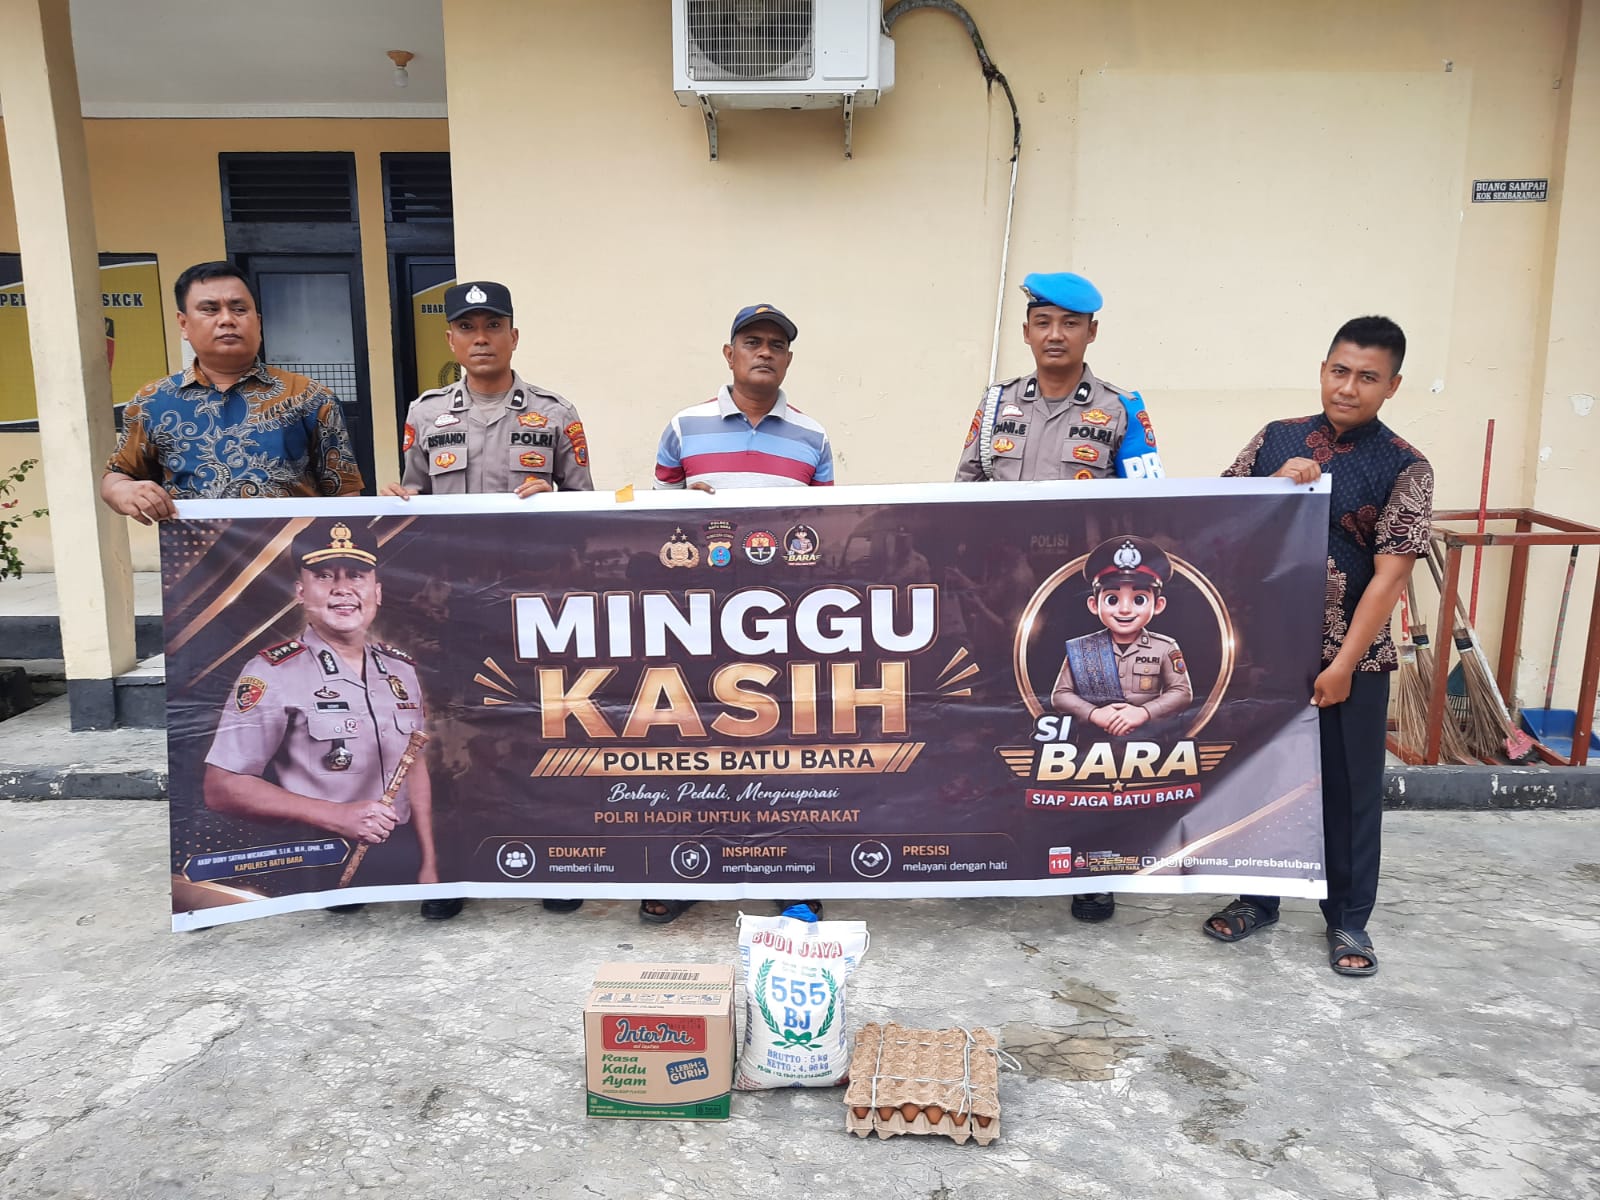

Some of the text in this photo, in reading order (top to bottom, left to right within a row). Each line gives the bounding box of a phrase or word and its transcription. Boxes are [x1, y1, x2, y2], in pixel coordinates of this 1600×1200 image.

[1476, 181, 1546, 191] BUANG SAMPAH
[1475, 191, 1545, 200] KOK SEMBARANGAN
[101, 293, 144, 307] SKCK
[511, 432, 553, 447] POLRI
[1069, 426, 1112, 443] POLRI
[1031, 534, 1069, 548] POLISI
[788, 554, 817, 562] BARA
[514, 585, 936, 660] MINGGU
[1135, 656, 1160, 664] POLRI
[538, 660, 908, 740] KASIH
[1034, 715, 1072, 741] SI
[603, 748, 875, 771] POLRES BATU BARA
[1036, 740, 1199, 781] BARA
[736, 781, 841, 807] Menginspirasi
[1032, 787, 1194, 807] SIAP JAGA BATU BARA
[594, 809, 861, 824] POLRI HADIR UNTUK MASYARAKAT
[548, 847, 607, 858] EDUKATIF
[722, 846, 788, 858] INSPIRATIF
[902, 845, 950, 856] PRESISI
[234, 855, 304, 872] KAPOLRES BATU BARA
[549, 863, 615, 873] memberi ilmu
[722, 863, 816, 875] membangun mimpi
[902, 860, 1008, 872] melayani dengan hati
[1051, 859, 1069, 869] 110
[1184, 856, 1321, 870] @humas_polresbatubara
[752, 930, 843, 959] BUDI JAYA
[771, 975, 827, 1007] 555
[783, 1006, 812, 1031] BJ
[616, 1017, 694, 1044] InterMi
[601, 1053, 639, 1063] Rasa
[767, 1049, 801, 1064] BRUTTO
[810, 1055, 816, 1063] 5
[817, 1054, 828, 1062] kg
[602, 1063, 647, 1075] Kaldu
[675, 1062, 698, 1073] LEBIH
[767, 1058, 791, 1072] NETTO
[819, 1062, 829, 1070] kg
[602, 1075, 647, 1088] Ayam
[670, 1067, 707, 1082] GURIH
